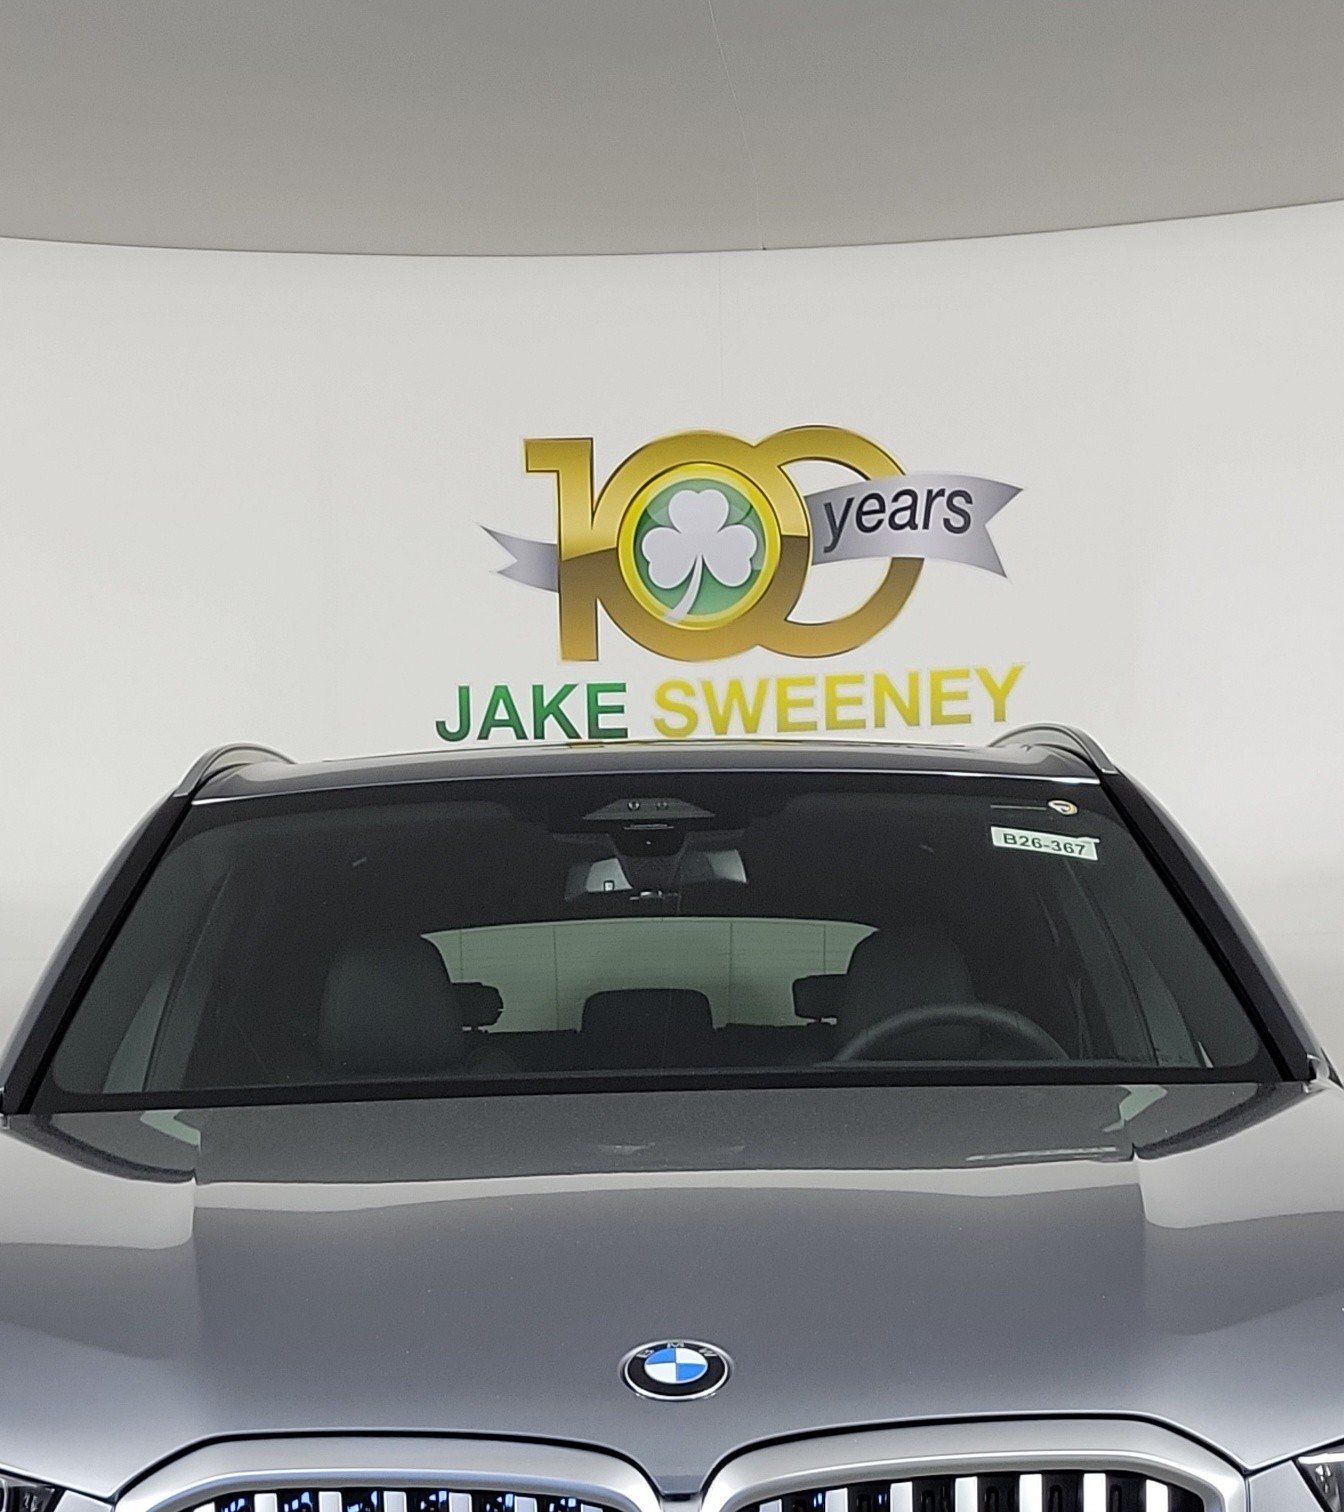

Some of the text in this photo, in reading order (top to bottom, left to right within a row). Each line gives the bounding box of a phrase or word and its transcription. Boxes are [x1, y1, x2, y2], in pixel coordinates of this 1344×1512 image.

[524, 425, 973, 662] 100 years
[435, 666, 1025, 742] JAKE SWEENEY
[1003, 833, 1085, 856] B26-367
